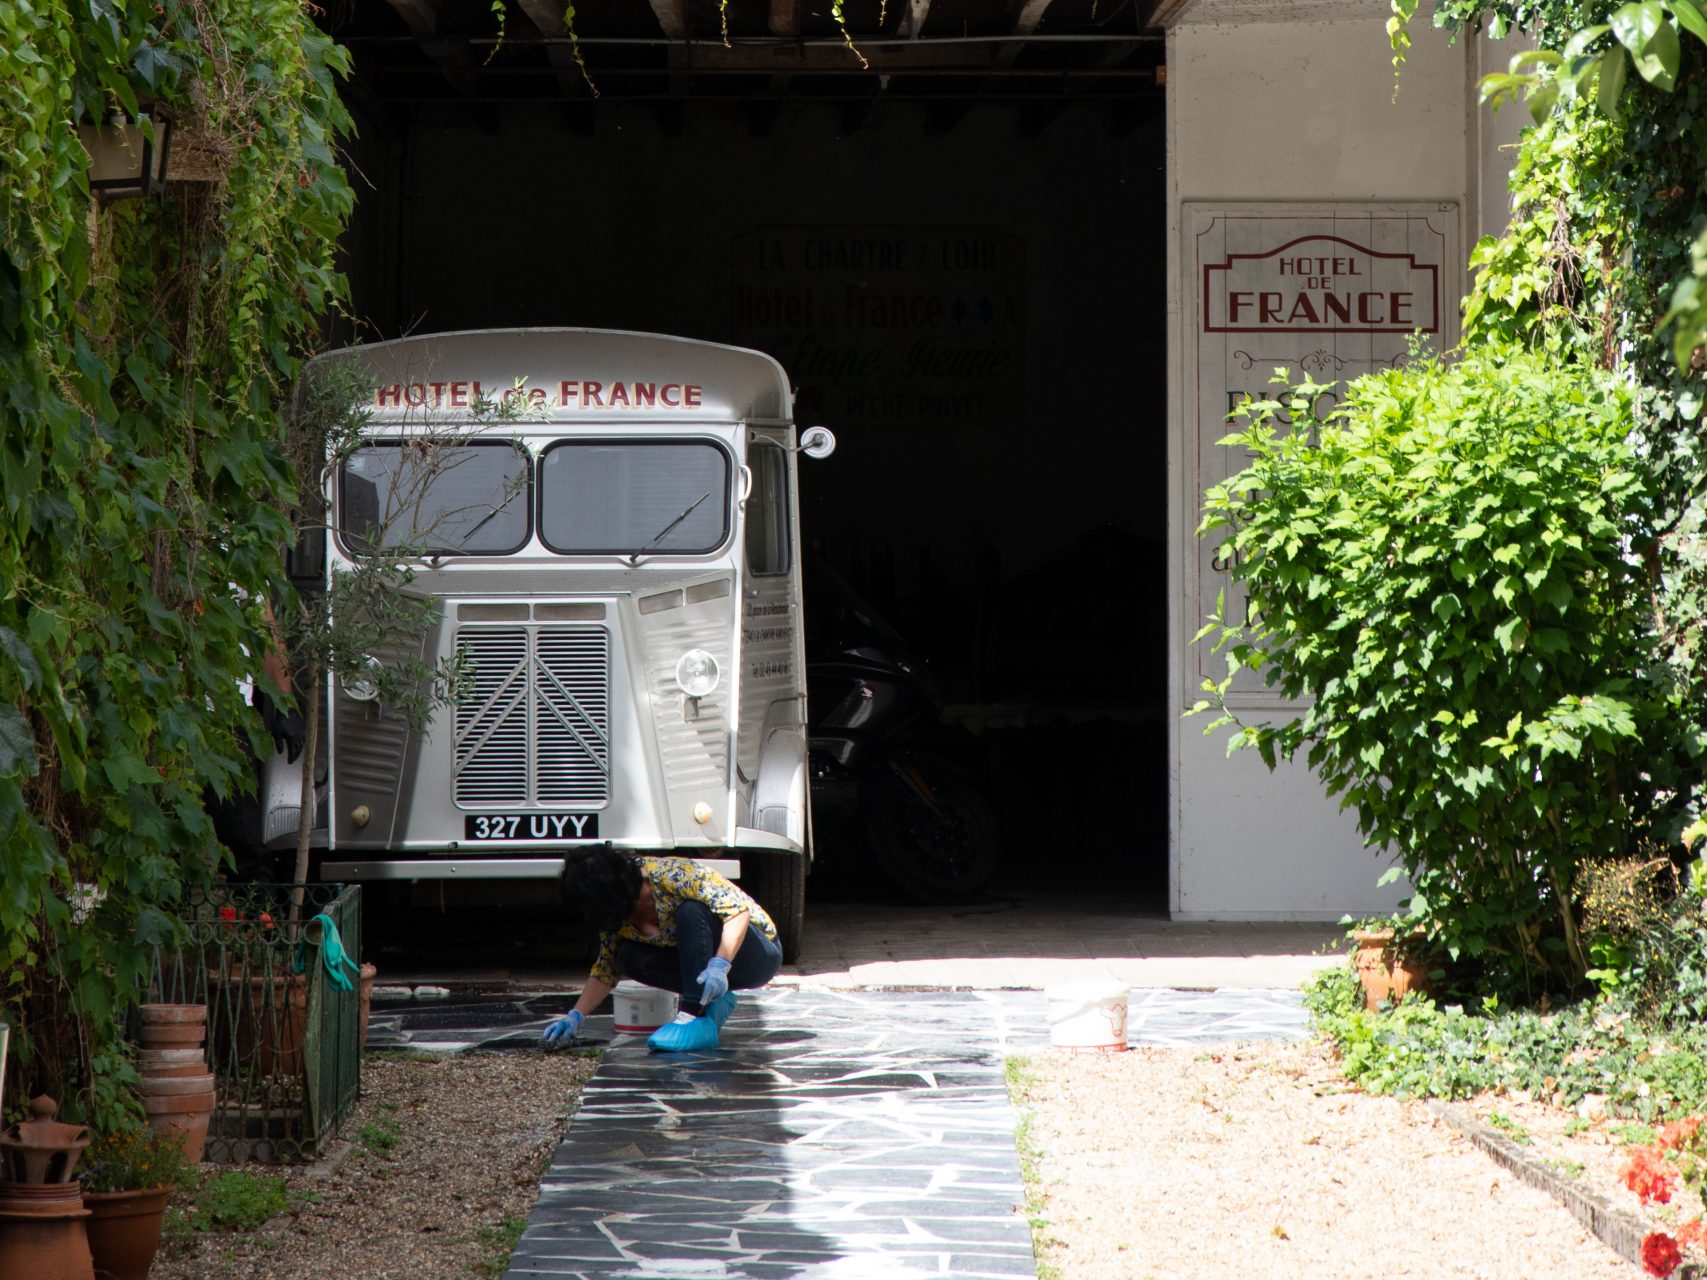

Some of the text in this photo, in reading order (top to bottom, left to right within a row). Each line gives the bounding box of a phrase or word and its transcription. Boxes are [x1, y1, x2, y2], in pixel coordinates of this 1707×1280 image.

[759, 240, 785, 271] LA
[804, 240, 908, 271] CHARTRE
[942, 240, 998, 271] LOIR
[1279, 257, 1362, 275] HOTEL
[1307, 276, 1331, 289] DE
[845, 285, 942, 328] France
[1229, 292, 1413, 323] FRANCE
[558, 380, 702, 409] FRANCE
[475, 815, 588, 838] 327 UYY
